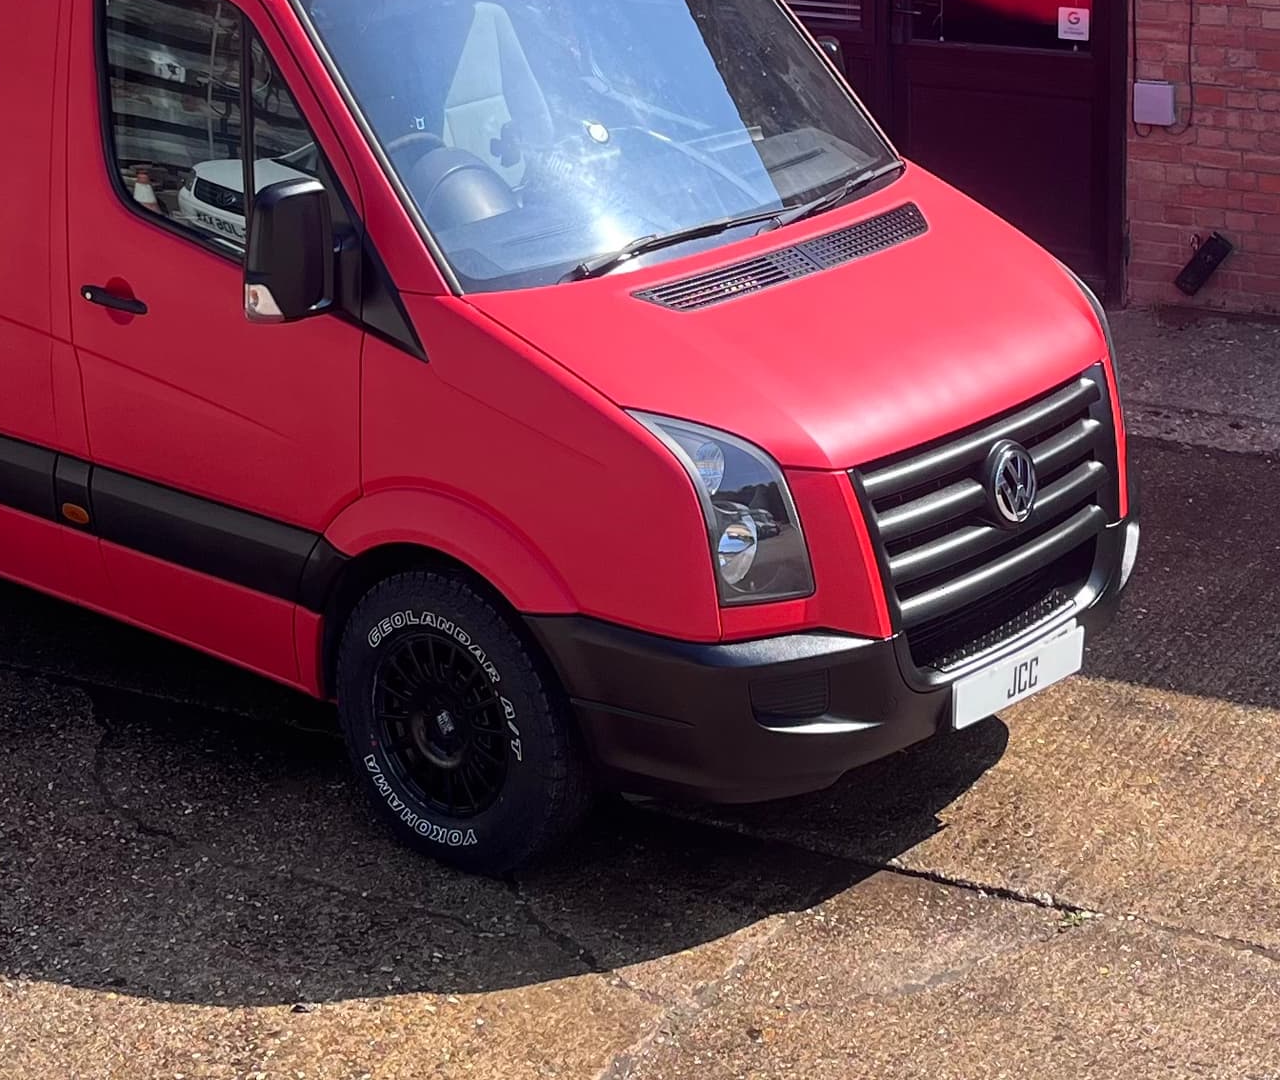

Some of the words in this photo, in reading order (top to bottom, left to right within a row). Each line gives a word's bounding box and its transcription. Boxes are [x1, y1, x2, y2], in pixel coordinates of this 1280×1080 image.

[368, 610, 501, 683] GEOLANDAR
[500, 696, 522, 761] A/T
[1007, 656, 1039, 699] JCC
[363, 754, 478, 846] YOKOHAMA
